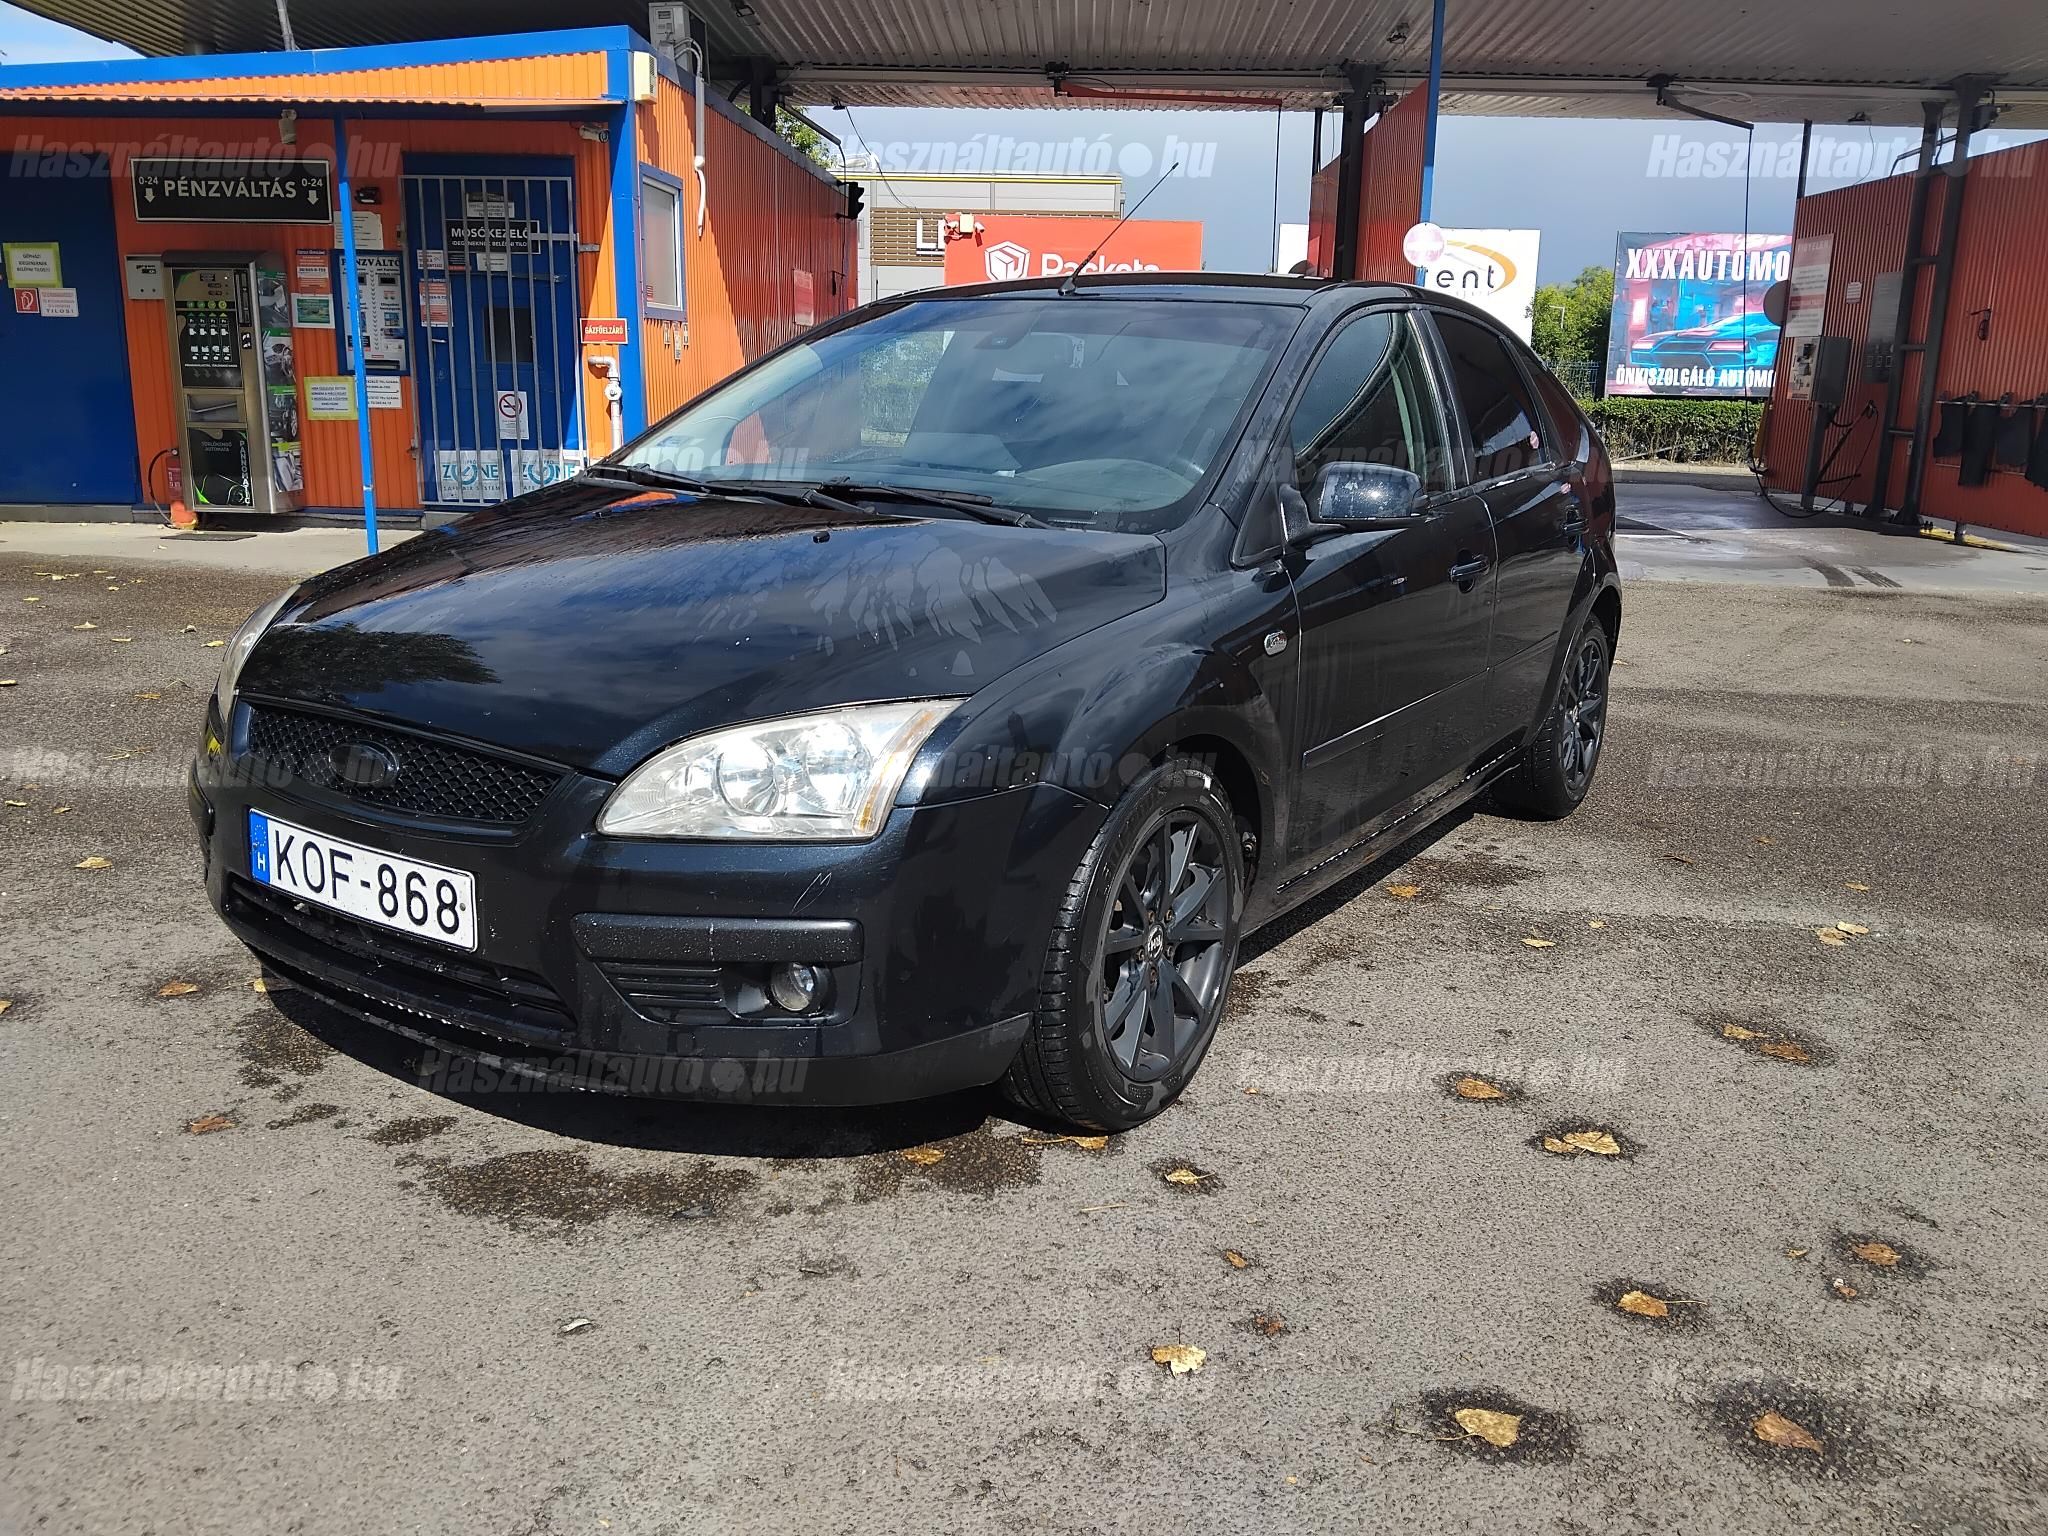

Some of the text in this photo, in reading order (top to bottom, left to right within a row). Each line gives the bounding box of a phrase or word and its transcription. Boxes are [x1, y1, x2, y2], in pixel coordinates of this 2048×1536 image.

[138, 176, 324, 198] 0-24 PÉNZVÁLTÁS 0-24
[1616, 364, 1715, 387] ÖNKISZOLGÁLÓ
[257, 830, 460, 935] H KOF-868
